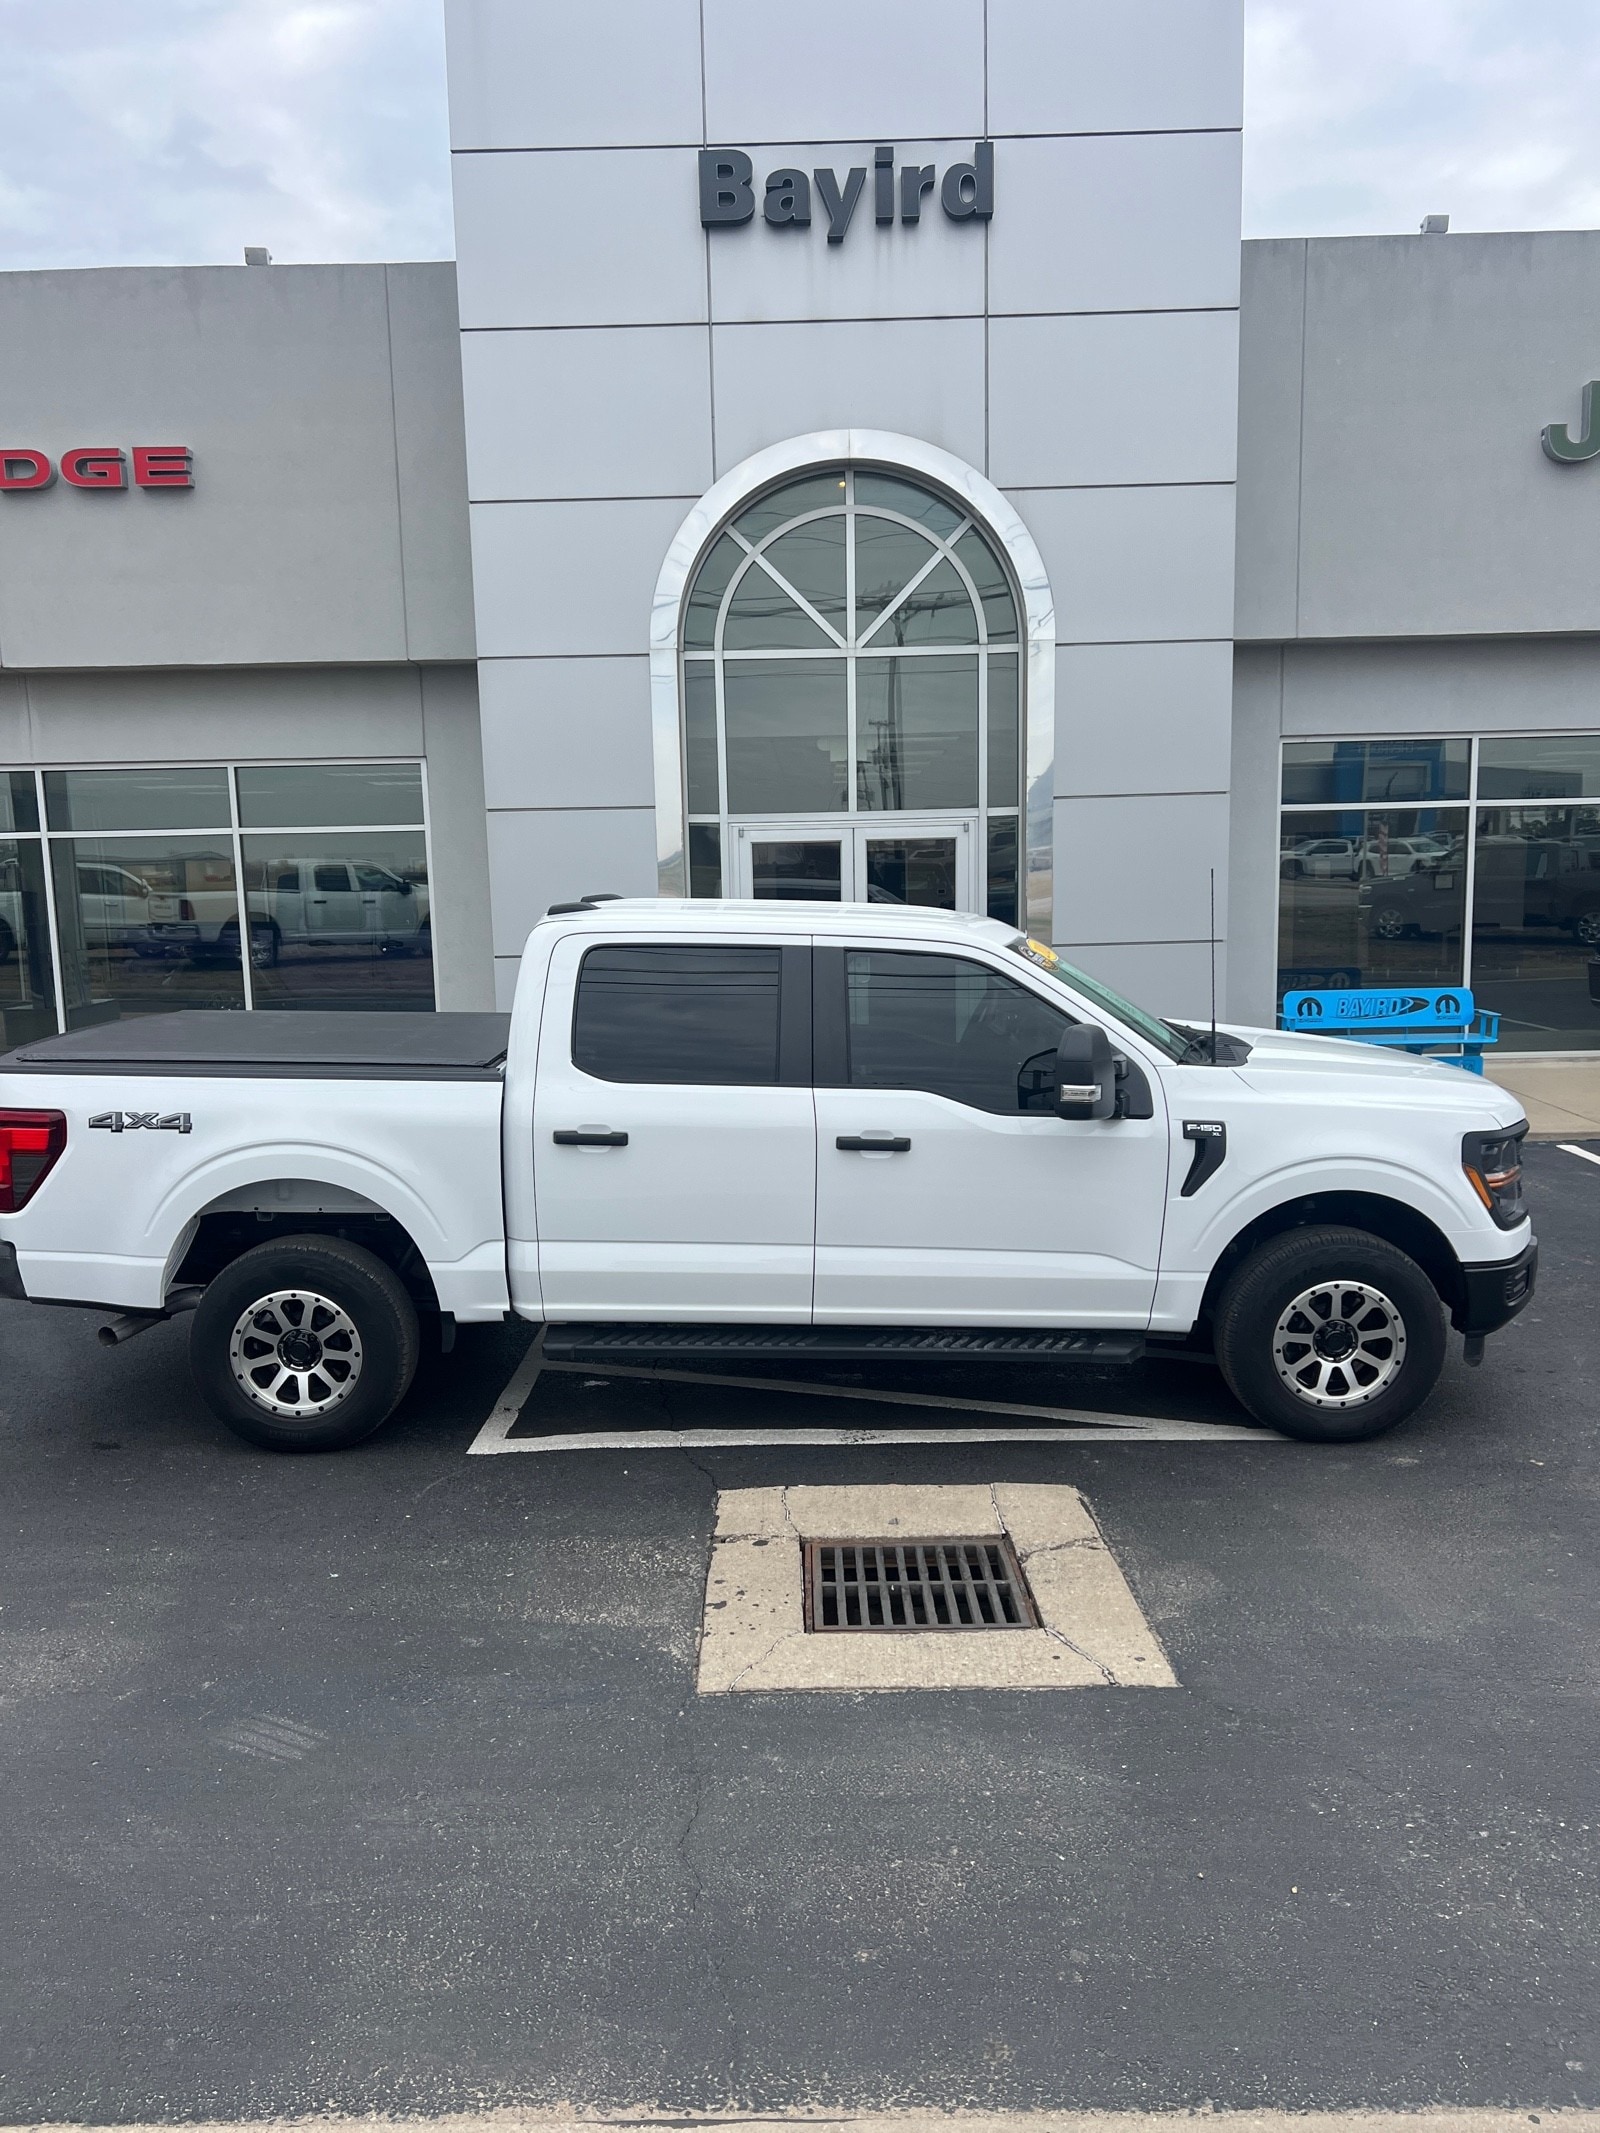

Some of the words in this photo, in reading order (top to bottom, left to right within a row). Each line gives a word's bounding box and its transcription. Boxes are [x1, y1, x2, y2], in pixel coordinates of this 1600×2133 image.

[698, 142, 994, 243] Bayird
[0, 446, 195, 490] DGE
[1337, 998, 1401, 1017] BAYIRD
[1187, 1124, 1222, 1132] F-150
